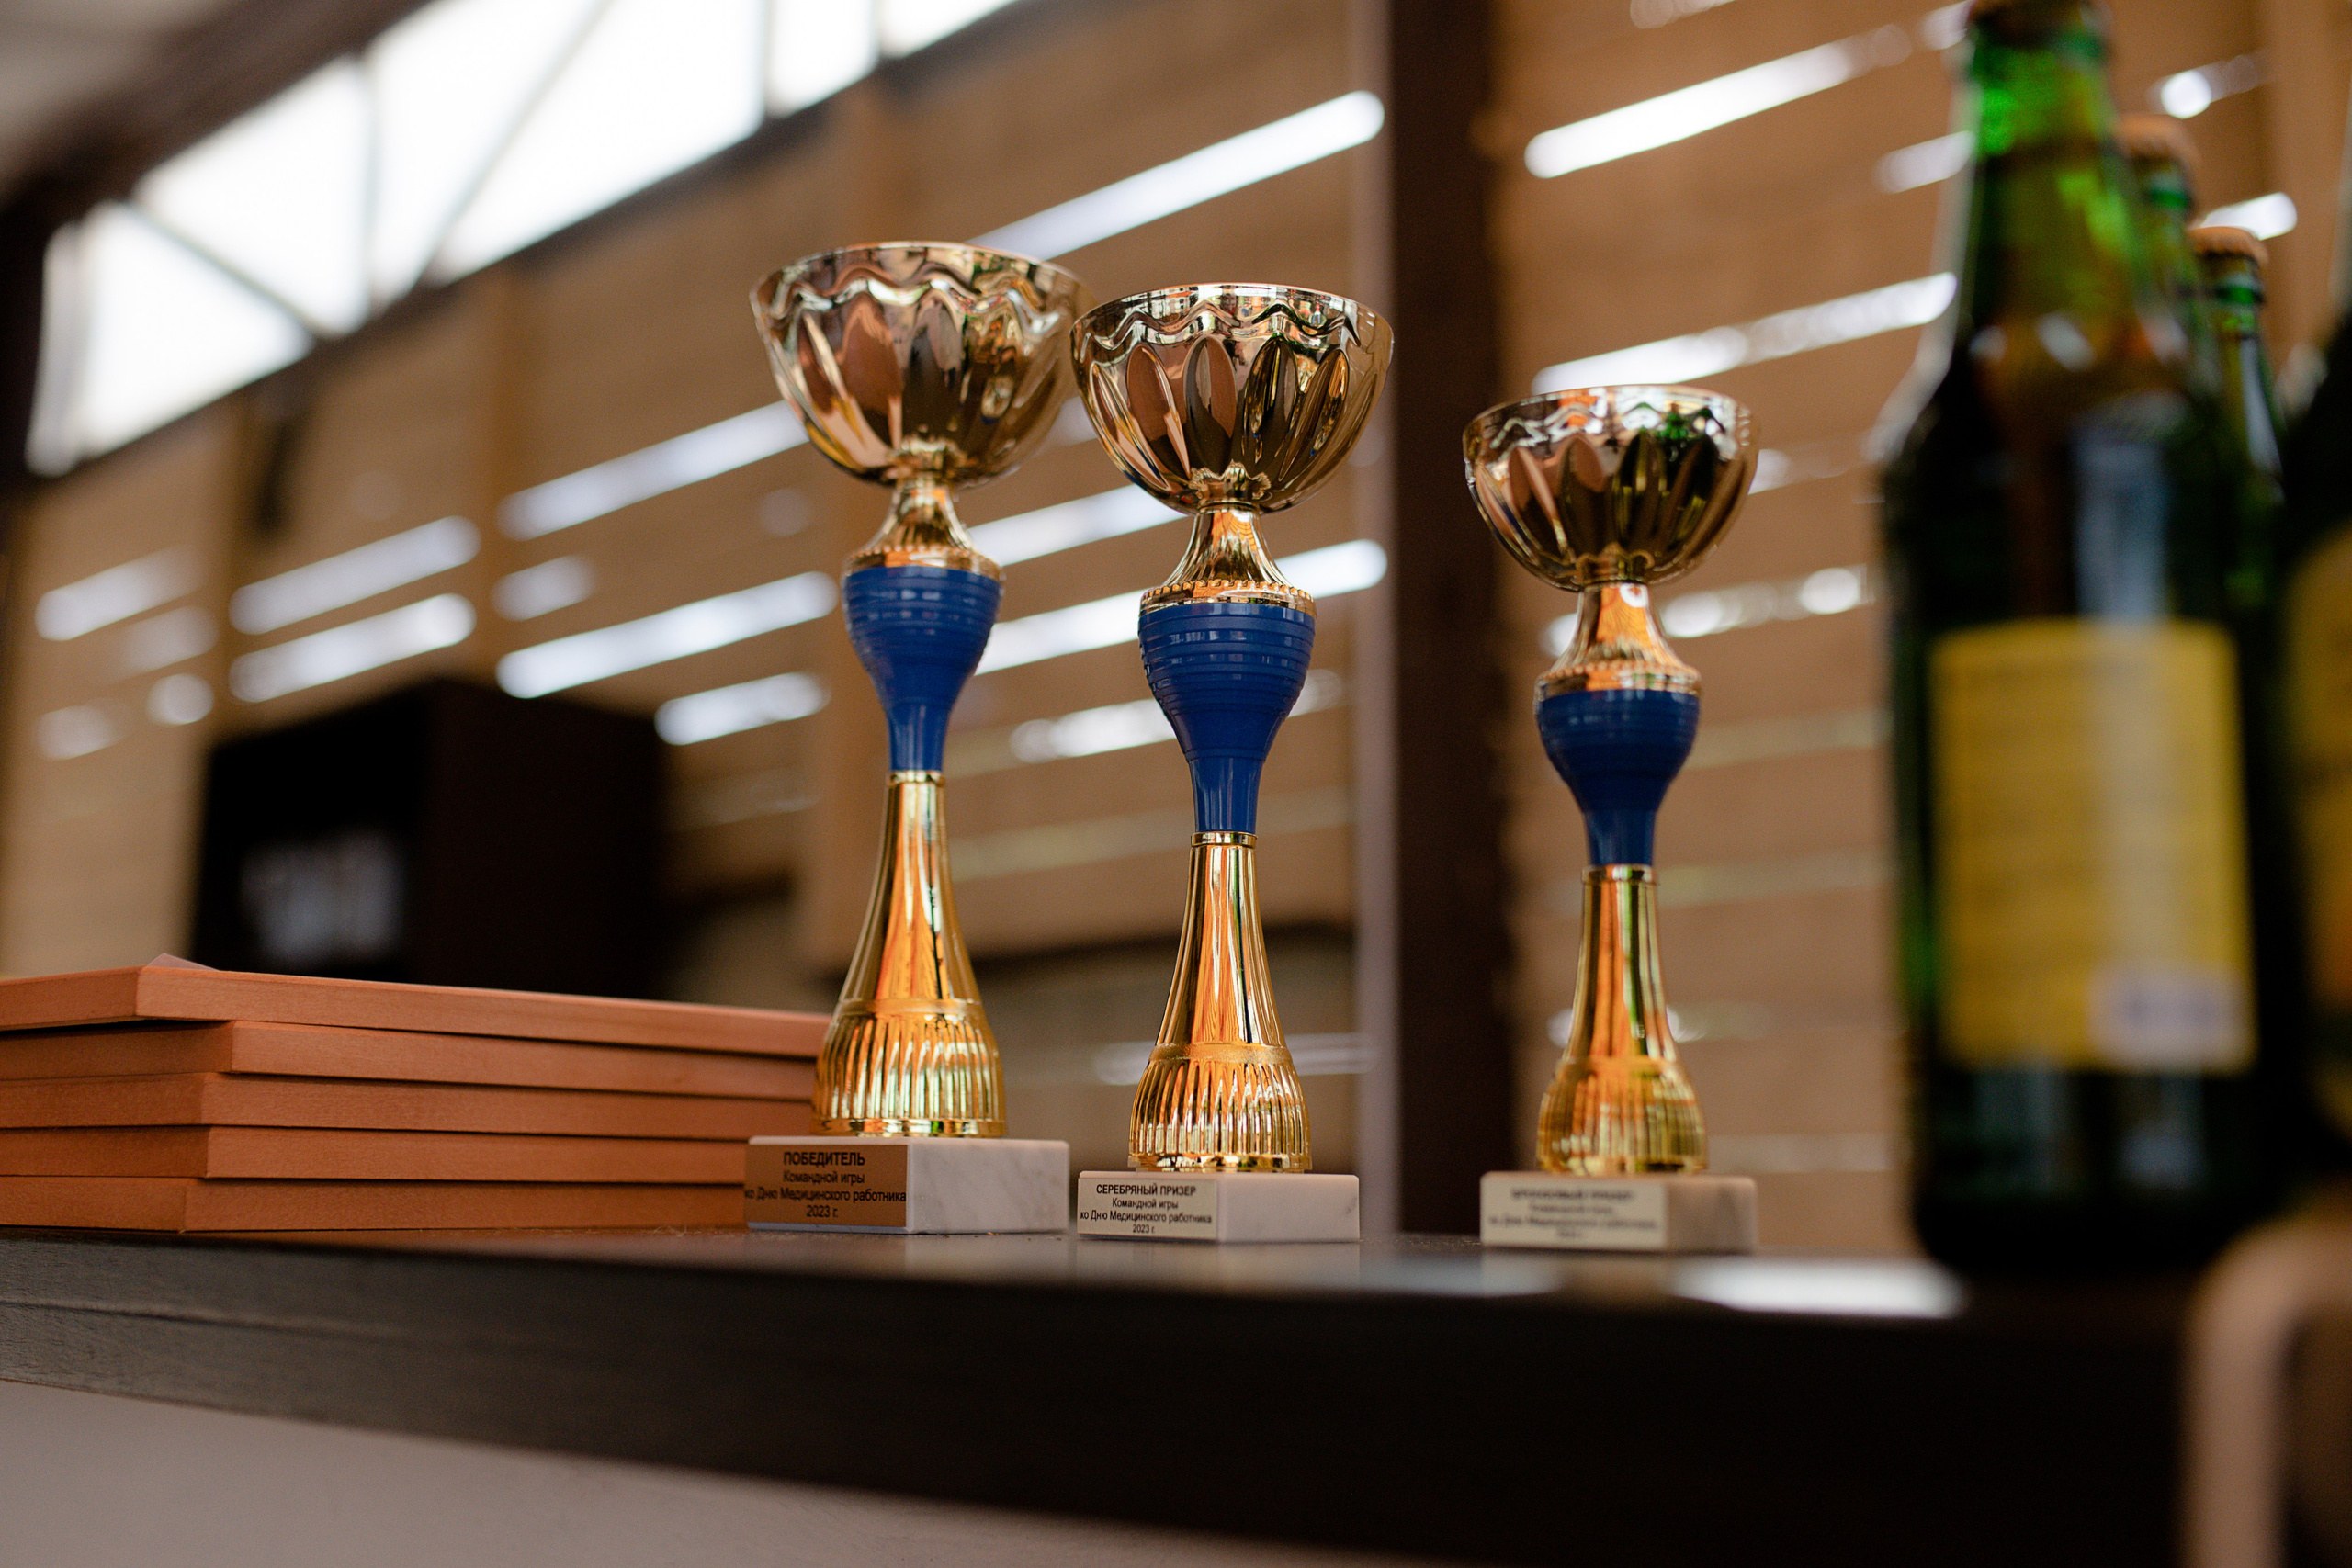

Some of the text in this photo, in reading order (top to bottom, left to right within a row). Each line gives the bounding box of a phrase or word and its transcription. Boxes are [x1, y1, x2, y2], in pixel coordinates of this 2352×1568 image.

[784, 1151, 865, 1167] ПОБЕДИТЕЛЬ
[783, 1170, 865, 1185] Командной игры
[781, 1188, 851, 1201] Медицинского
[853, 1189, 907, 1203] работника
[1096, 1183, 1196, 1196] СЕРЕБРЯНЫЙ ПРИЗЕР
[1113, 1197, 1178, 1210] Командной игры
[807, 1205, 838, 1218] 2023 г.
[1080, 1210, 1212, 1224] ко Дню Медицинского работника
[1133, 1224, 1149, 1234] 2023
